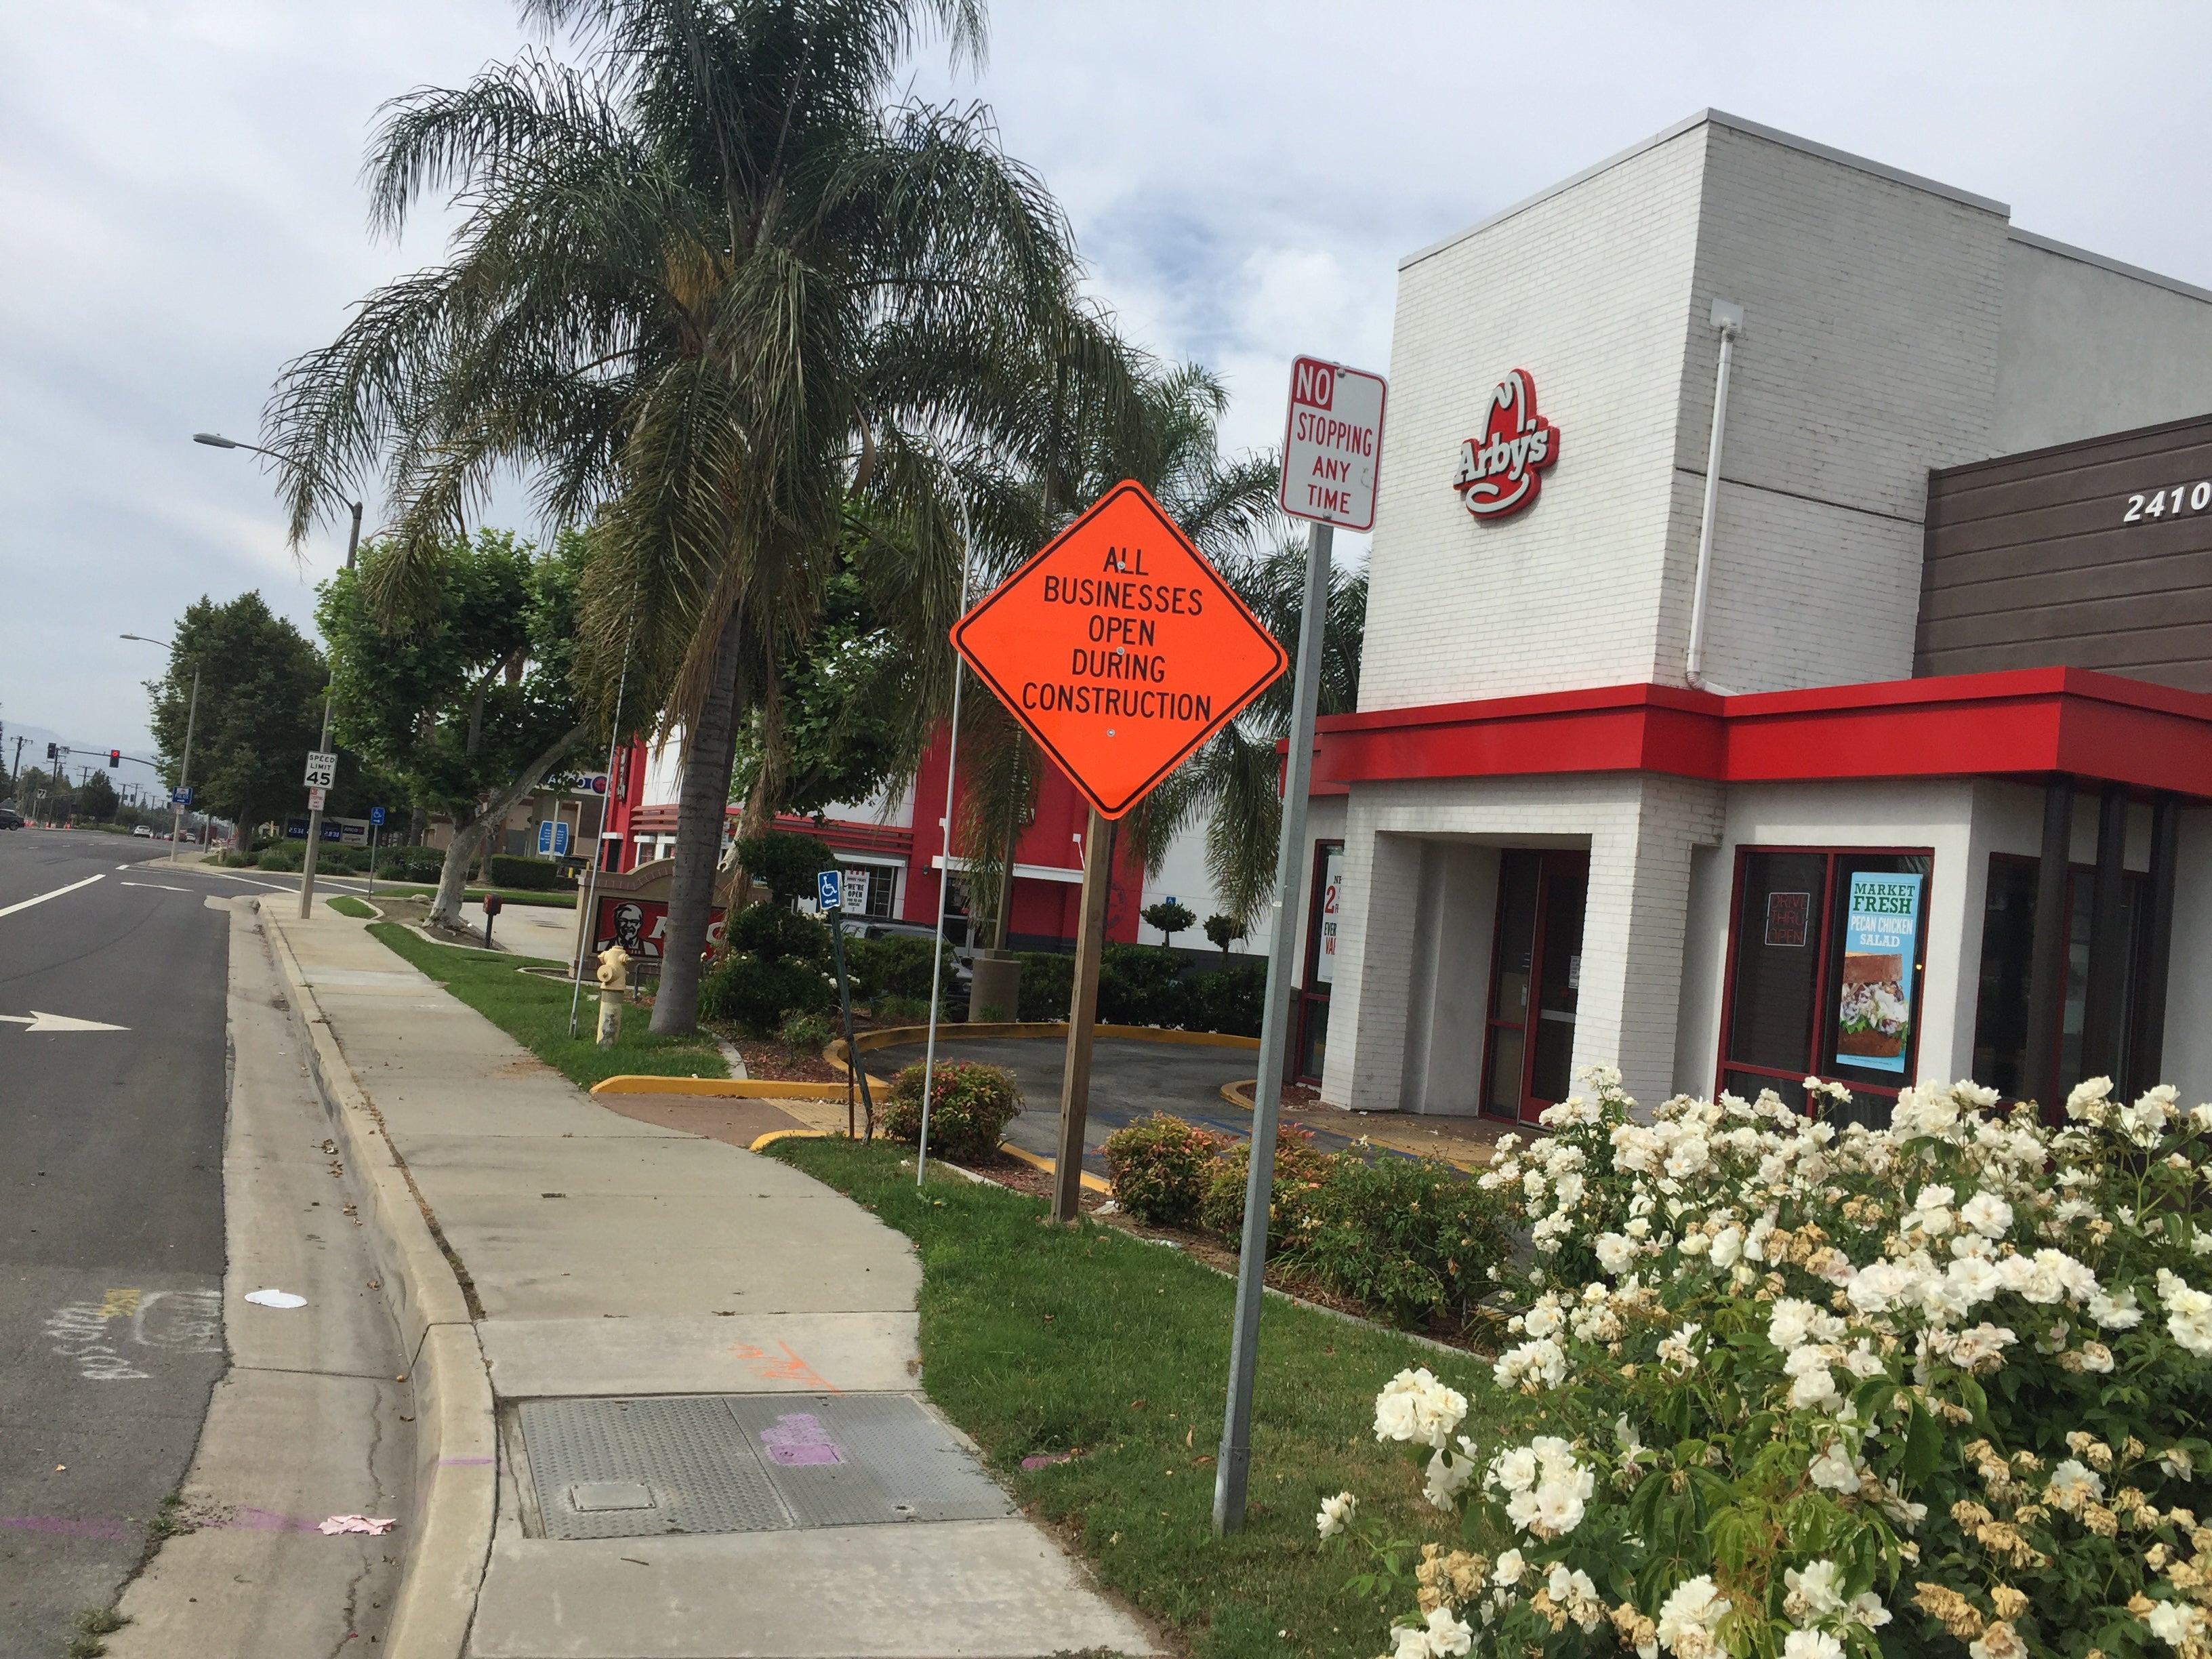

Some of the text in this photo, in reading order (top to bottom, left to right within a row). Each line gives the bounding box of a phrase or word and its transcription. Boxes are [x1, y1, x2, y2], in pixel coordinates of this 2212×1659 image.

[1296, 363, 1331, 406] NO
[1297, 411, 1373, 457] STOPPING
[1453, 418, 1549, 486] Arby's
[1311, 455, 1351, 483] ANY
[1307, 483, 1351, 514] TIME
[2123, 481, 2211, 523] 2410
[1103, 546, 1149, 576] ALL
[1044, 575, 1203, 616] BUSINESSES
[1088, 614, 1155, 647] OPEN
[1071, 648, 1166, 683] DURING
[1022, 681, 1211, 722] CONSTRUCTION
[310, 754, 335, 762] SPEED
[306, 771, 330, 785] 45
[1771, 895, 1807, 910] DRIVE
[1854, 883, 1916, 897] MARKET
[1771, 909, 1804, 926] THRU
[1852, 895, 1912, 915] FRESH
[1768, 928, 1803, 944] OPEN
[1851, 916, 1913, 935] PECAN CHICKEN
[1860, 933, 1900, 947] SALAD
